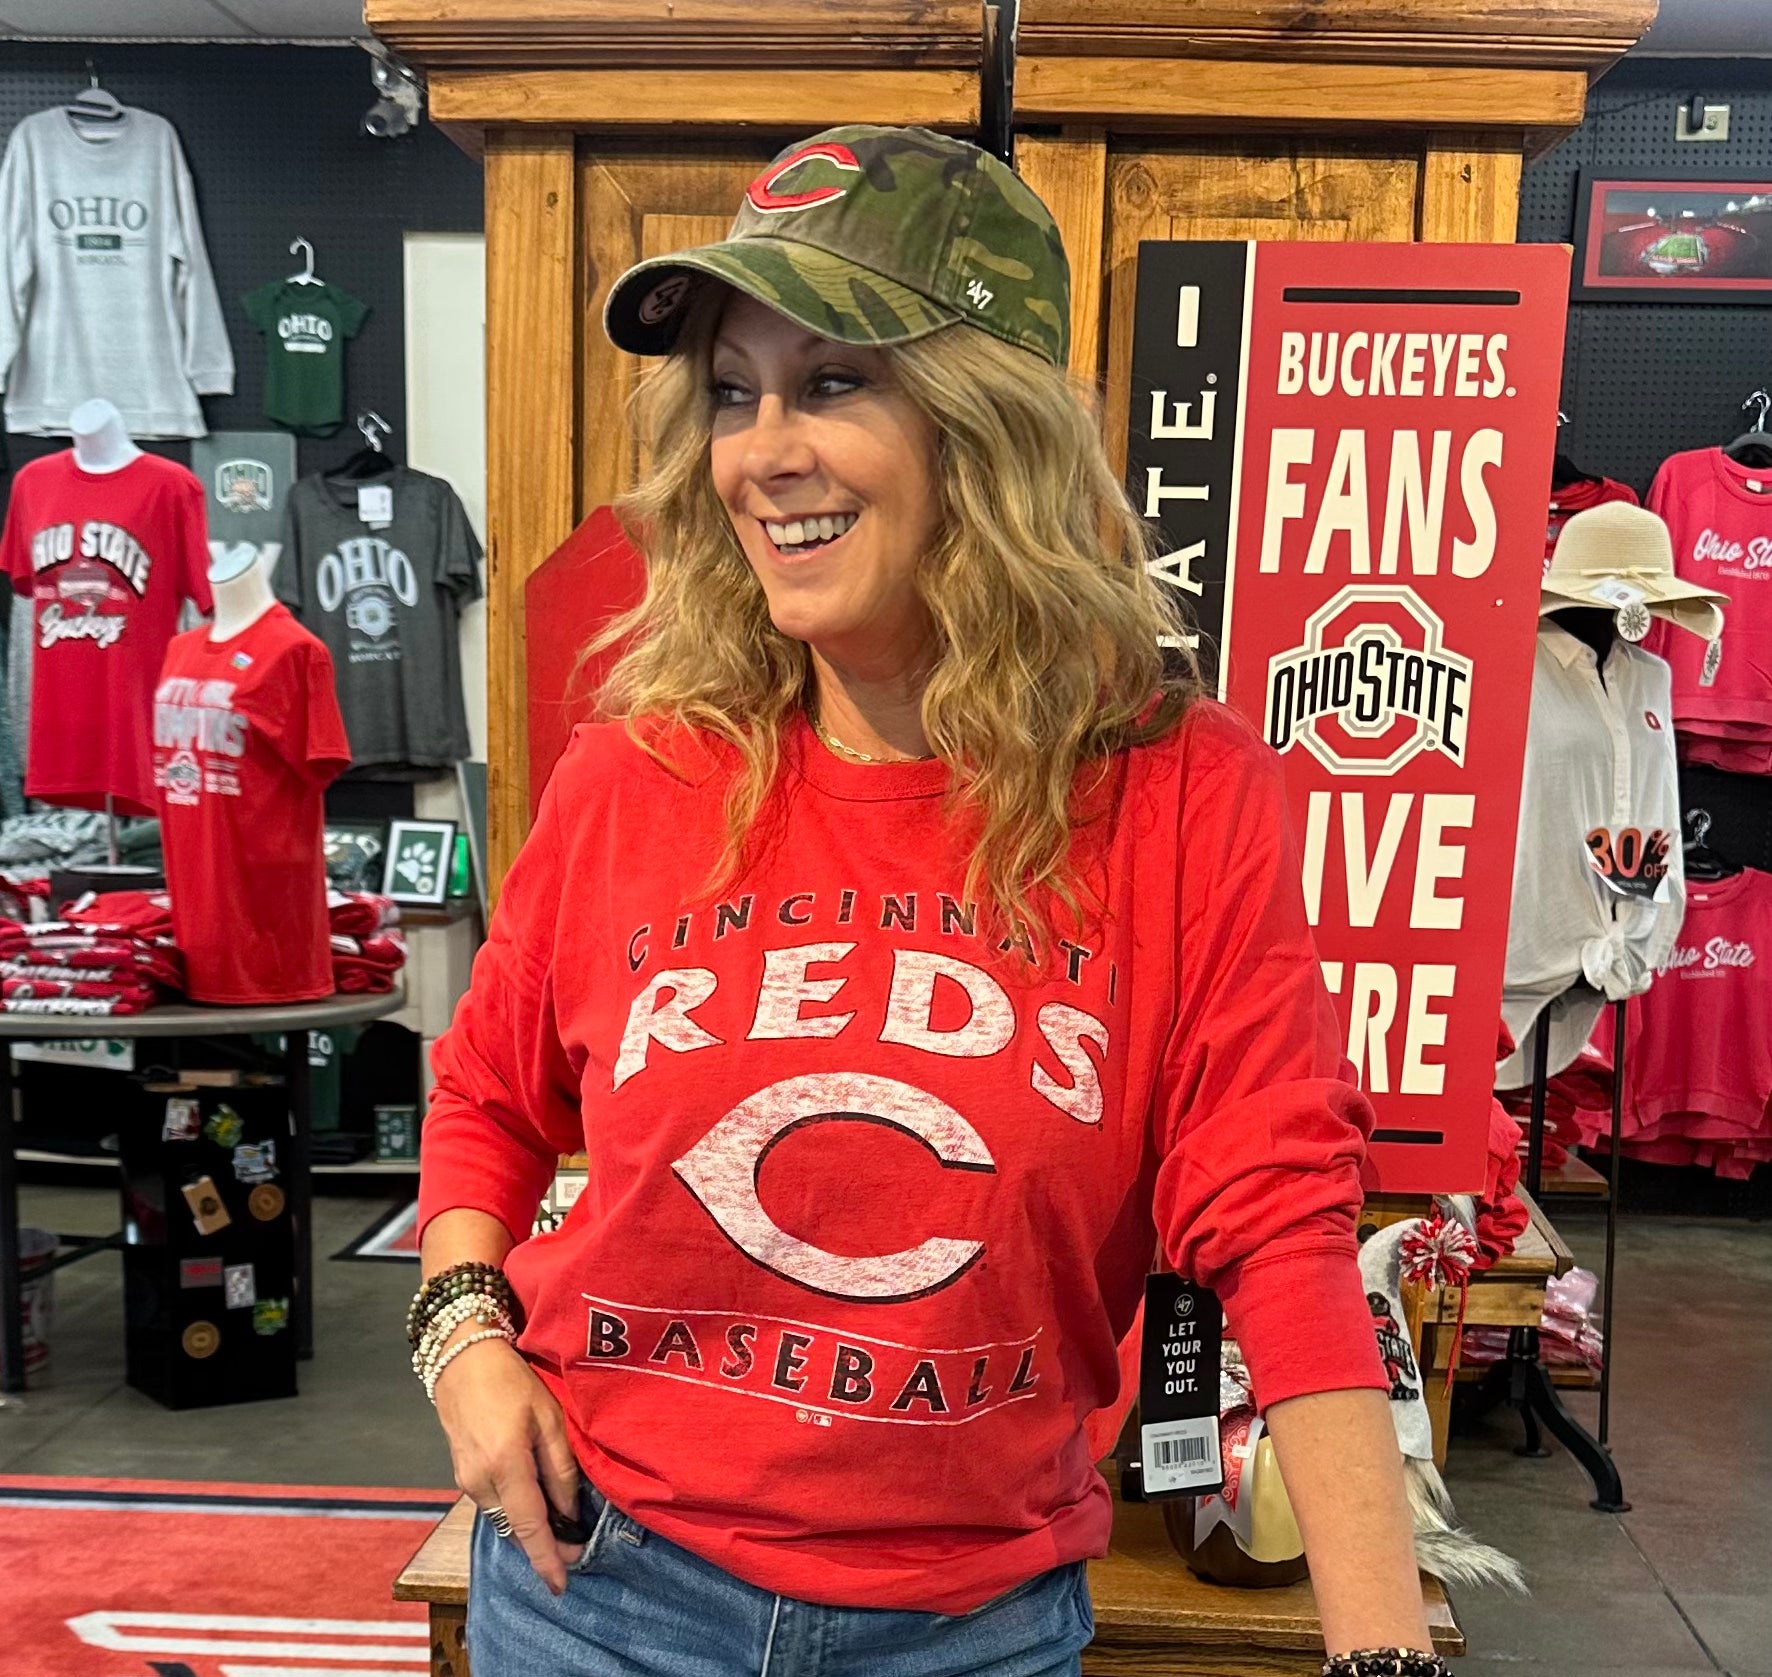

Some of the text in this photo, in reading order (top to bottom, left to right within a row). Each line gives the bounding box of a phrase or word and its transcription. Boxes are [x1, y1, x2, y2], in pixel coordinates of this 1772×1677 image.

[48, 197, 148, 231] OHIO
[278, 313, 333, 341] OHIO
[1259, 428, 1504, 579] FANS
[1693, 528, 1744, 562] Ohio
[317, 537, 419, 613] OHIO
[1301, 791, 1476, 930] IVE
[628, 889, 1117, 1006] CINCINNATI
[1703, 936, 1755, 969] State
[612, 941, 1110, 1125] REDS
[671, 1071, 997, 1304] C
[1169, 1321, 1197, 1338] LET
[588, 1306, 1042, 1413] BASEBALL
[1162, 1340, 1202, 1358] YOUR
[1166, 1359, 1196, 1376] YOU
[1165, 1378, 1199, 1395] OUT.
